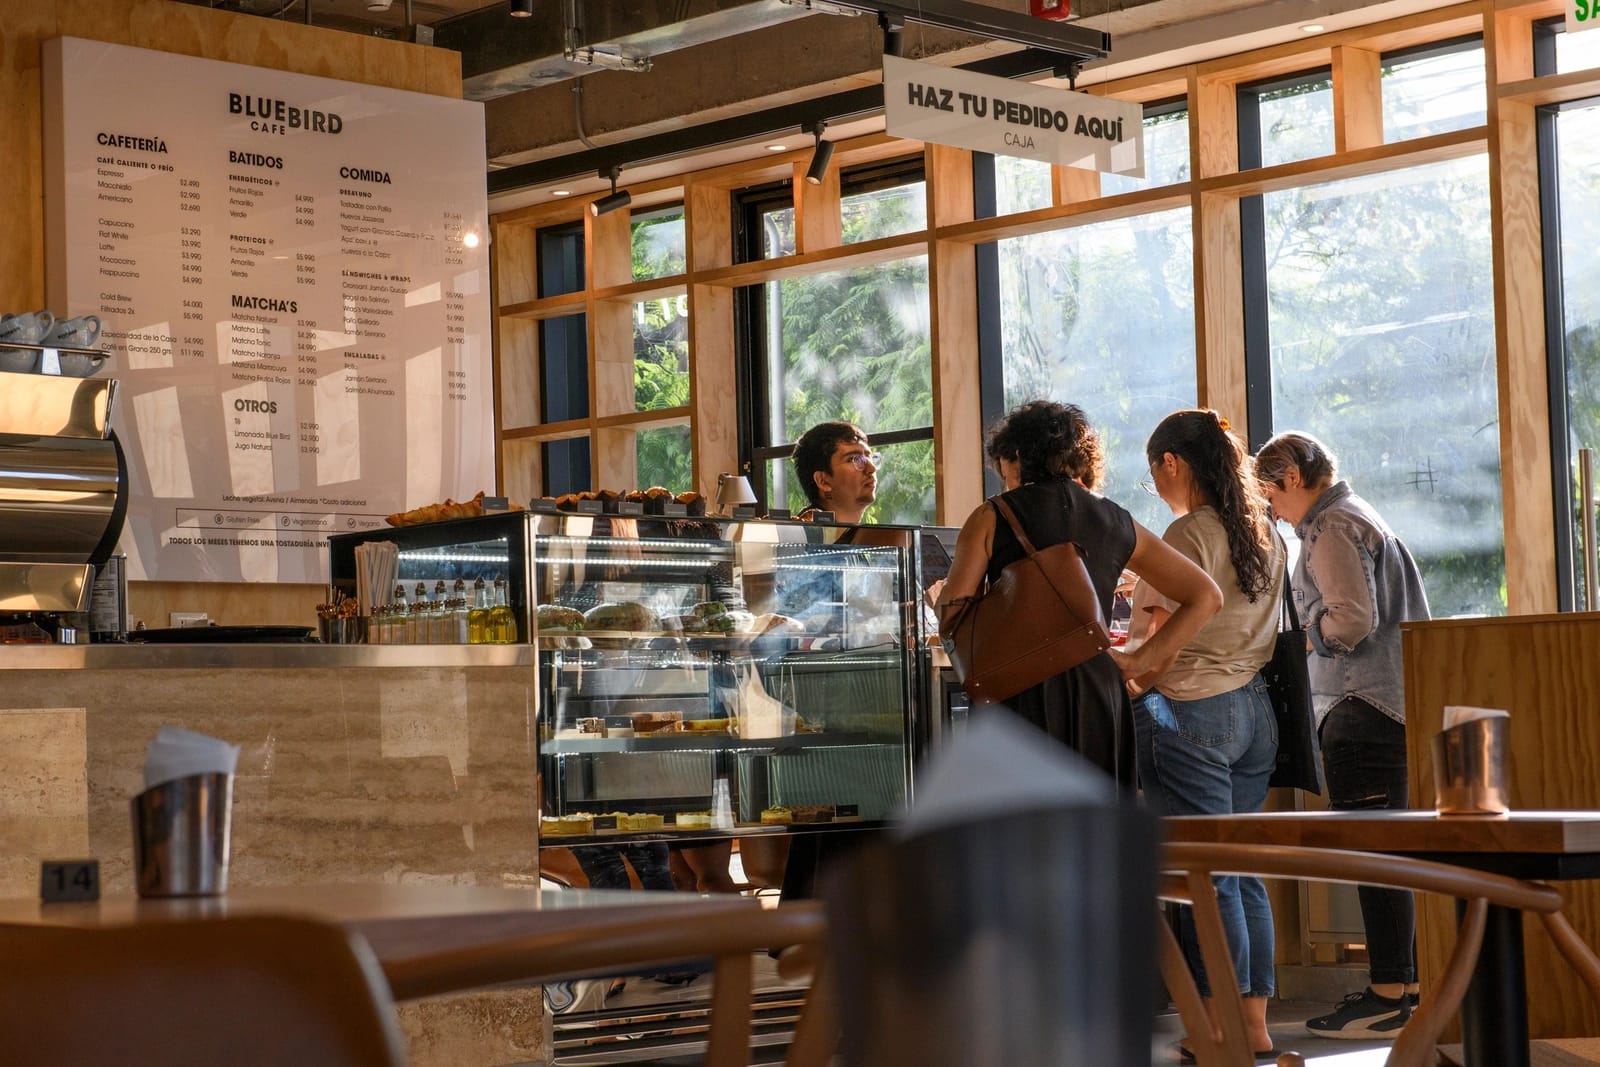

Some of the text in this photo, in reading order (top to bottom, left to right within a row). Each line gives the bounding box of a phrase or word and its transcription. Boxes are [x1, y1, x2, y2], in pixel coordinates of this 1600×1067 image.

[229, 93, 342, 134] BLUEBIRD
[908, 82, 1123, 142] HAZ TU PEDIDO AQUÍ
[251, 121, 286, 135] CAFE
[97, 132, 168, 153] CAFETERÍA
[1004, 132, 1035, 150] CAJA
[229, 151, 283, 169] BATIDOS
[117, 159, 148, 169] CALIENTE
[159, 164, 174, 172] FRÍO
[97, 168, 124, 178] Espresso
[340, 167, 391, 184] COMIDA
[229, 175, 272, 186] ENERGÉTICOS
[98, 181, 132, 191] Macchiato
[229, 186, 246, 194] Frutos
[98, 193, 133, 203] Americano
[180, 192, 200, 200] $2.990
[230, 198, 254, 207] Amarillo
[99, 218, 134, 228] Capuccino
[99, 231, 128, 240] Flat White
[99, 243, 114, 251] Latte
[181, 240, 201, 248] $3.990
[182, 252, 201, 260] $3.990
[231, 258, 255, 267] Amarillo
[182, 264, 202, 272] $4.990
[100, 268, 139, 278] Frappuccino
[231, 270, 248, 278] Verde
[182, 276, 202, 285] $4.990
[100, 293, 116, 301] Cold
[232, 295, 297, 313] MATCHA'S
[101, 306, 126, 314] Filtrados
[184, 312, 203, 320] $5.990
[232, 313, 254, 321] Matcha
[232, 325, 255, 333] Matcha
[101, 330, 141, 340] Especialidad
[184, 337, 203, 345] $4.990
[232, 337, 255, 345] Matcha
[128, 345, 148, 353] Grano
[180, 349, 204, 357] $11.990
[232, 349, 280, 359] Matcha Naranja
[344, 352, 379, 360] ENSALADAS
[257, 375, 273, 383] Frutos
[275, 377, 291, 385] Rojos
[235, 399, 277, 414] OTROS
[235, 431, 264, 439] Limonada
[266, 432, 278, 440] Blue
[235, 443, 272, 451] Jugo Natural
[266, 496, 284, 504] Avena
[290, 497, 318, 505] Almendra
[226, 516, 260, 524] Gluten Free
[358, 519, 380, 528] Vegano
[276, 540, 314, 548] TOSTADURÍA
[50, 866, 94, 892] 14
